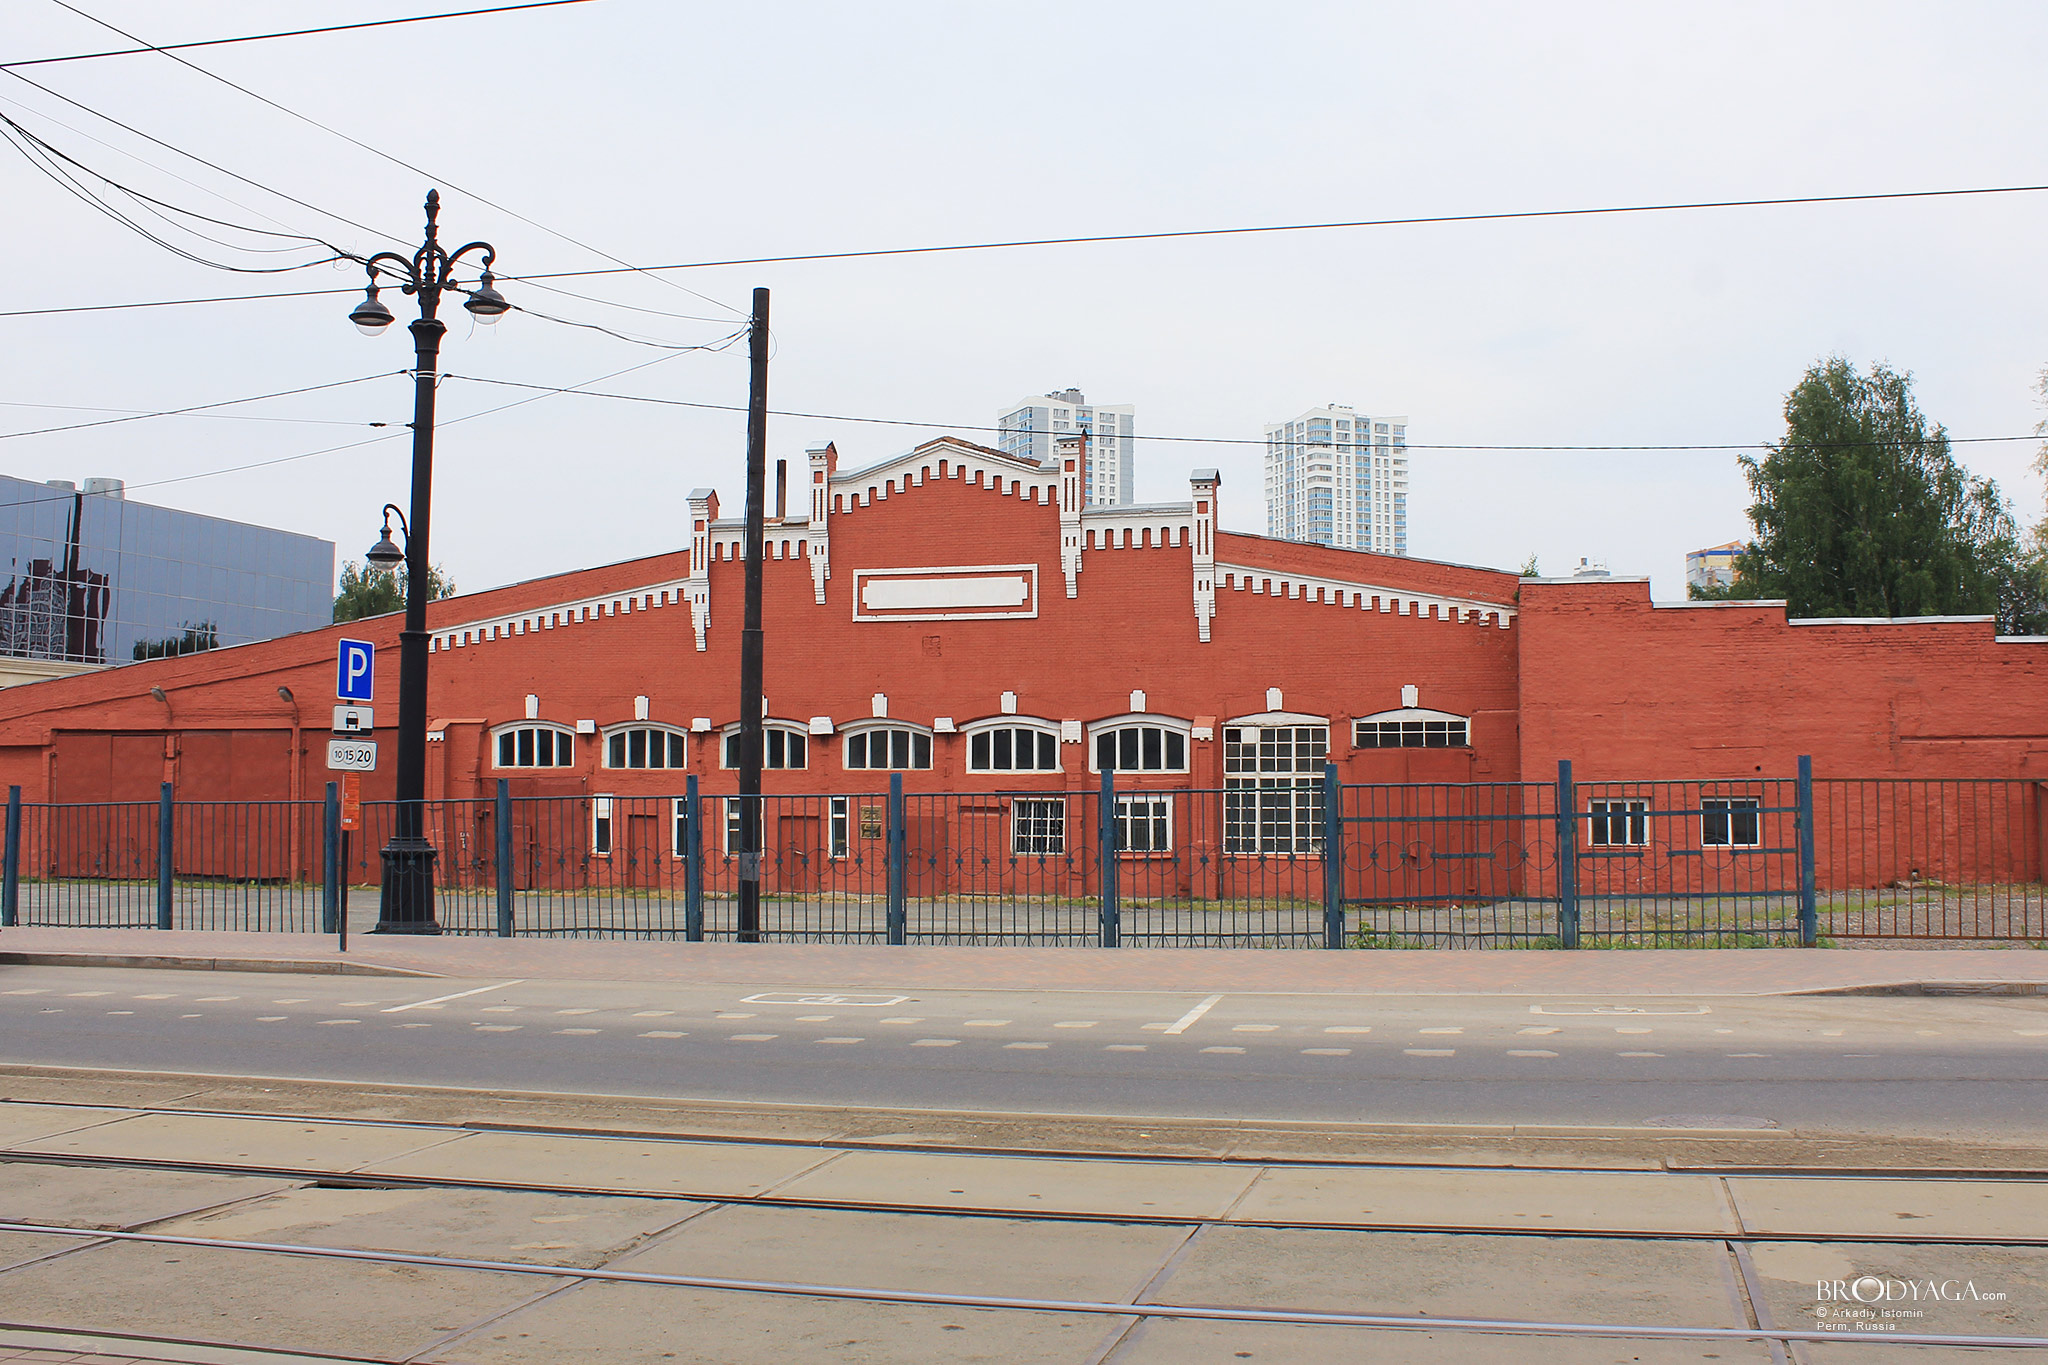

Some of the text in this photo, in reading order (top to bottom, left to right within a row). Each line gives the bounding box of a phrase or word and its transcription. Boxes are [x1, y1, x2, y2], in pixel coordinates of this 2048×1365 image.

[347, 647, 368, 692] P
[334, 750, 372, 763] 10 15 20
